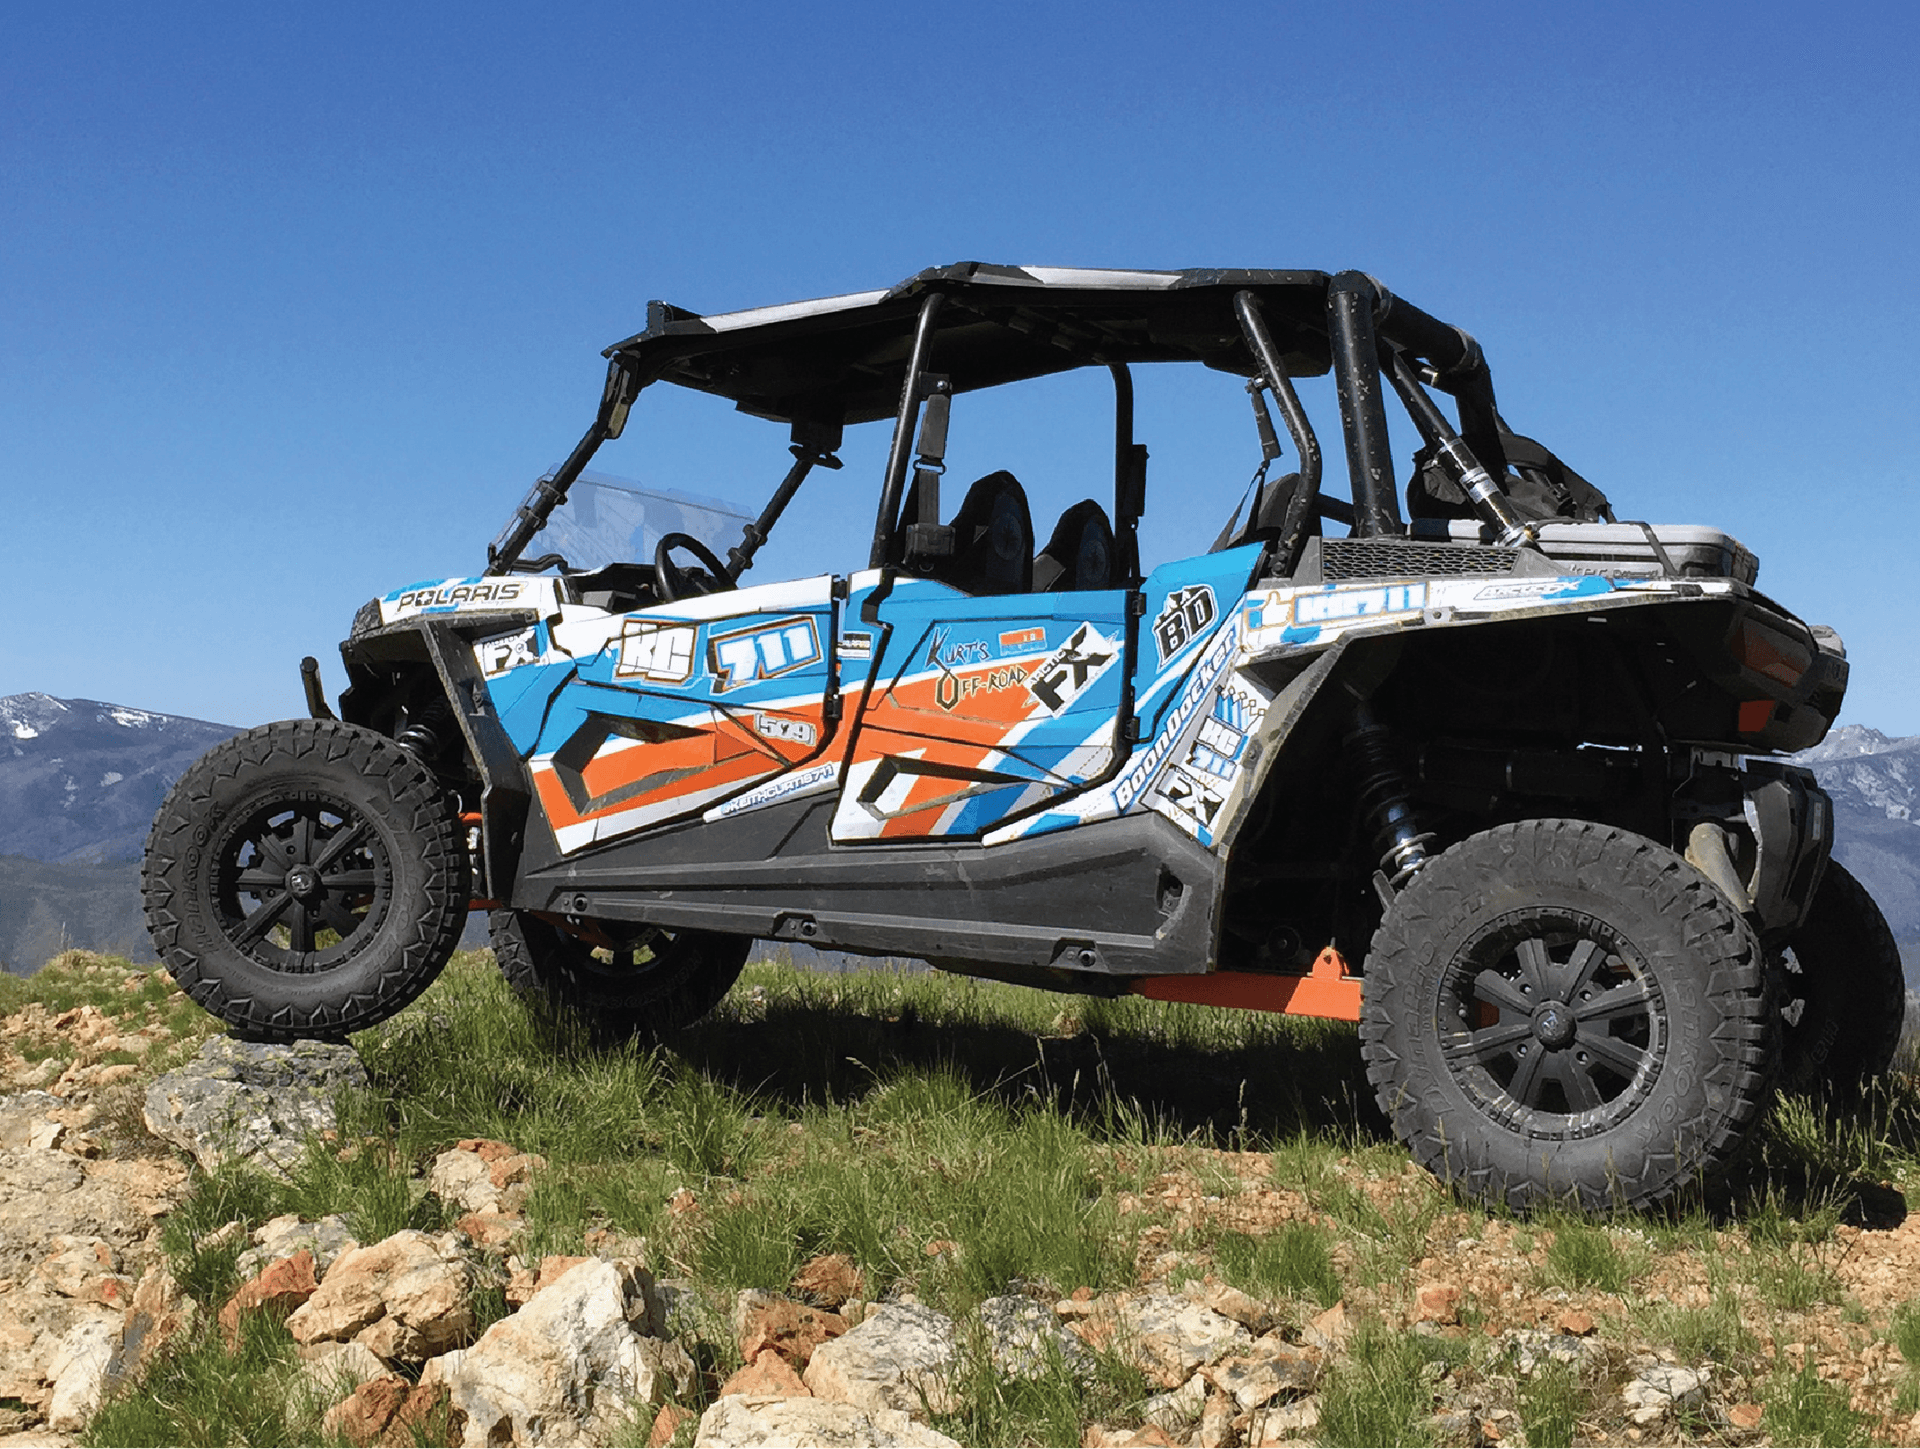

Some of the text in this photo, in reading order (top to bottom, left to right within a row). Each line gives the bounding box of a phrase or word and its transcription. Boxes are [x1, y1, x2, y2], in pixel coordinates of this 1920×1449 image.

[397, 582, 521, 613] POLARIS
[1157, 589, 1214, 662] BD
[719, 624, 814, 686] 711
[935, 664, 1028, 710] OFF-ROAD
[757, 713, 816, 746] 509
